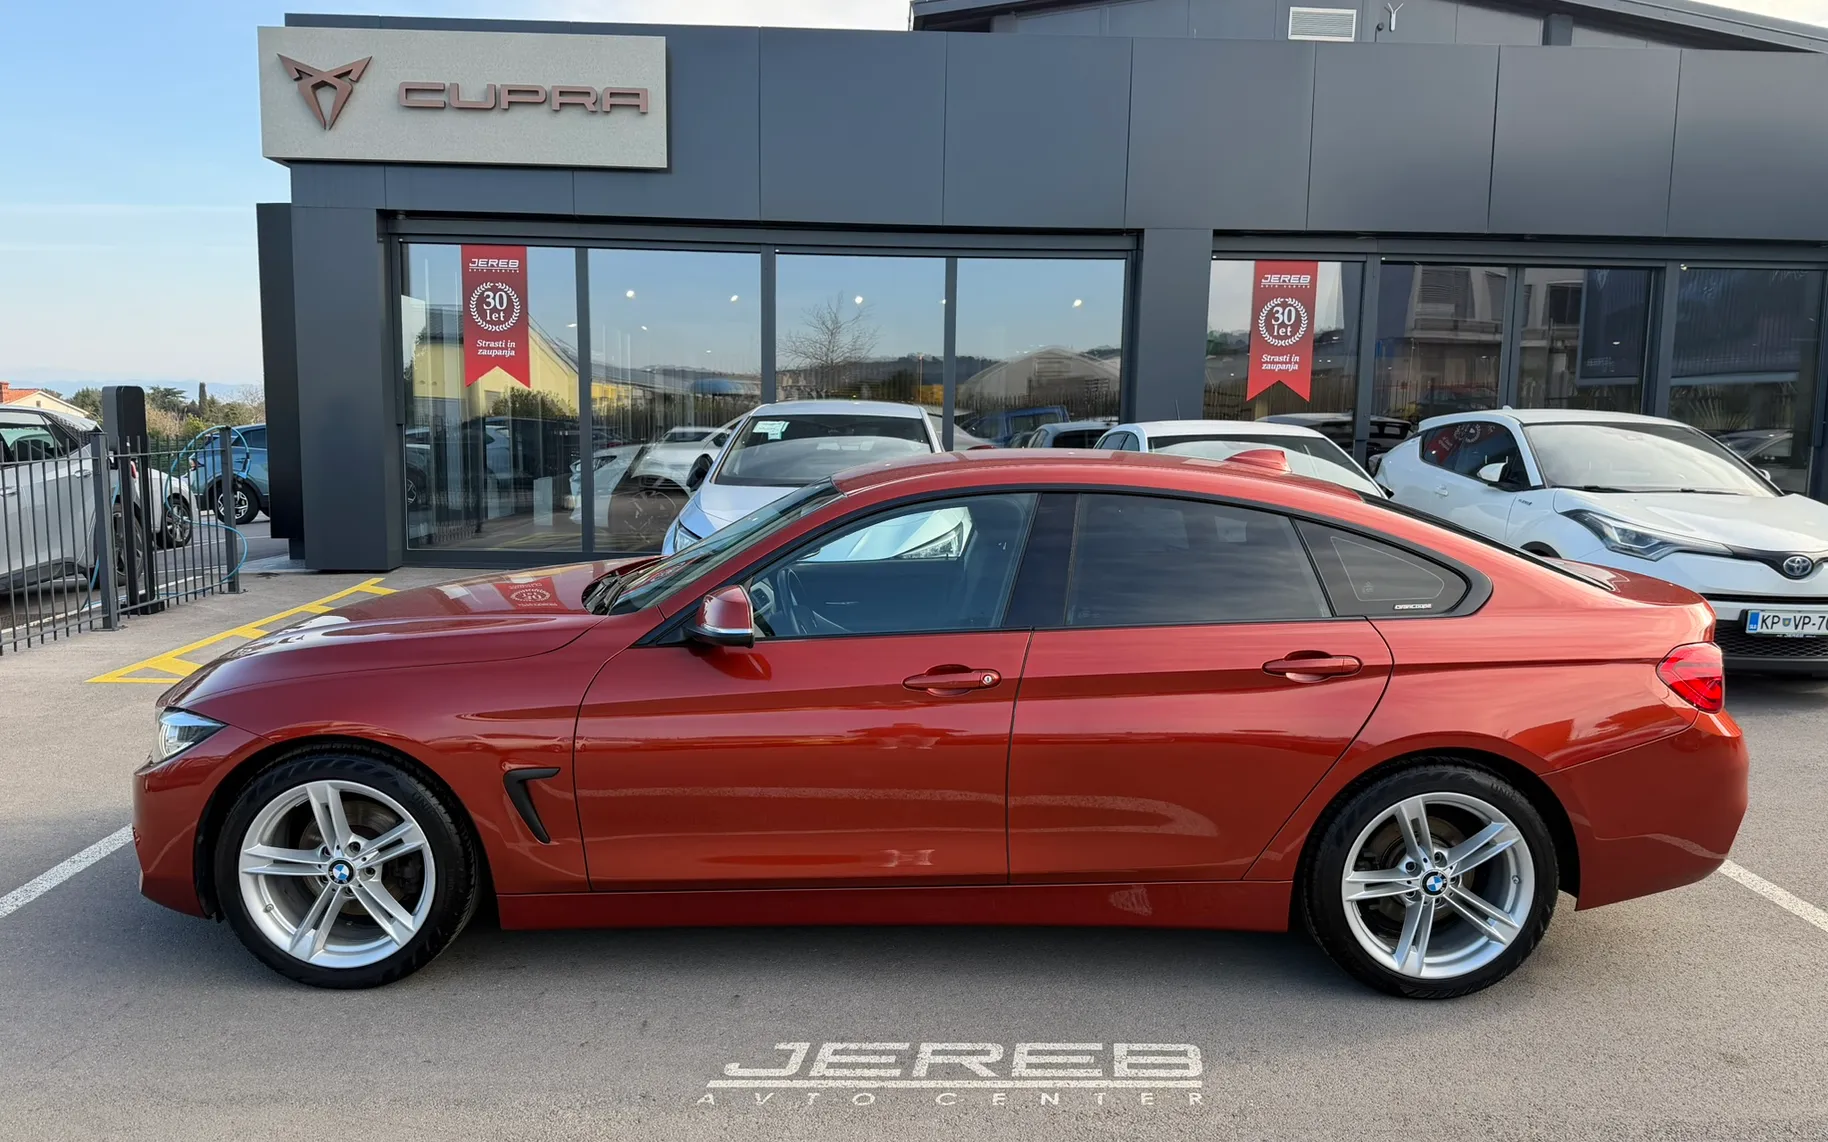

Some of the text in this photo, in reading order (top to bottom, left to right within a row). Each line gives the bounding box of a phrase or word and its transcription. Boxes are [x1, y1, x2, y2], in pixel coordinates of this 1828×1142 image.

[399, 81, 649, 114] CUPRA
[469, 258, 519, 268] JEREB
[1261, 274, 1311, 283] JEREB
[483, 291, 507, 310] 30
[486, 310, 505, 321] let
[1271, 306, 1296, 325] 30
[1273, 325, 1292, 336] let
[476, 339, 516, 348] Strasti in
[477, 348, 516, 357] zaupanja
[1261, 354, 1300, 362] Strasti in
[1261, 362, 1299, 371] zaupanja
[1760, 614, 1781, 630] KP
[724, 1042, 1203, 1077] JEREB
[697, 1092, 1204, 1106] AVTO CENTER
